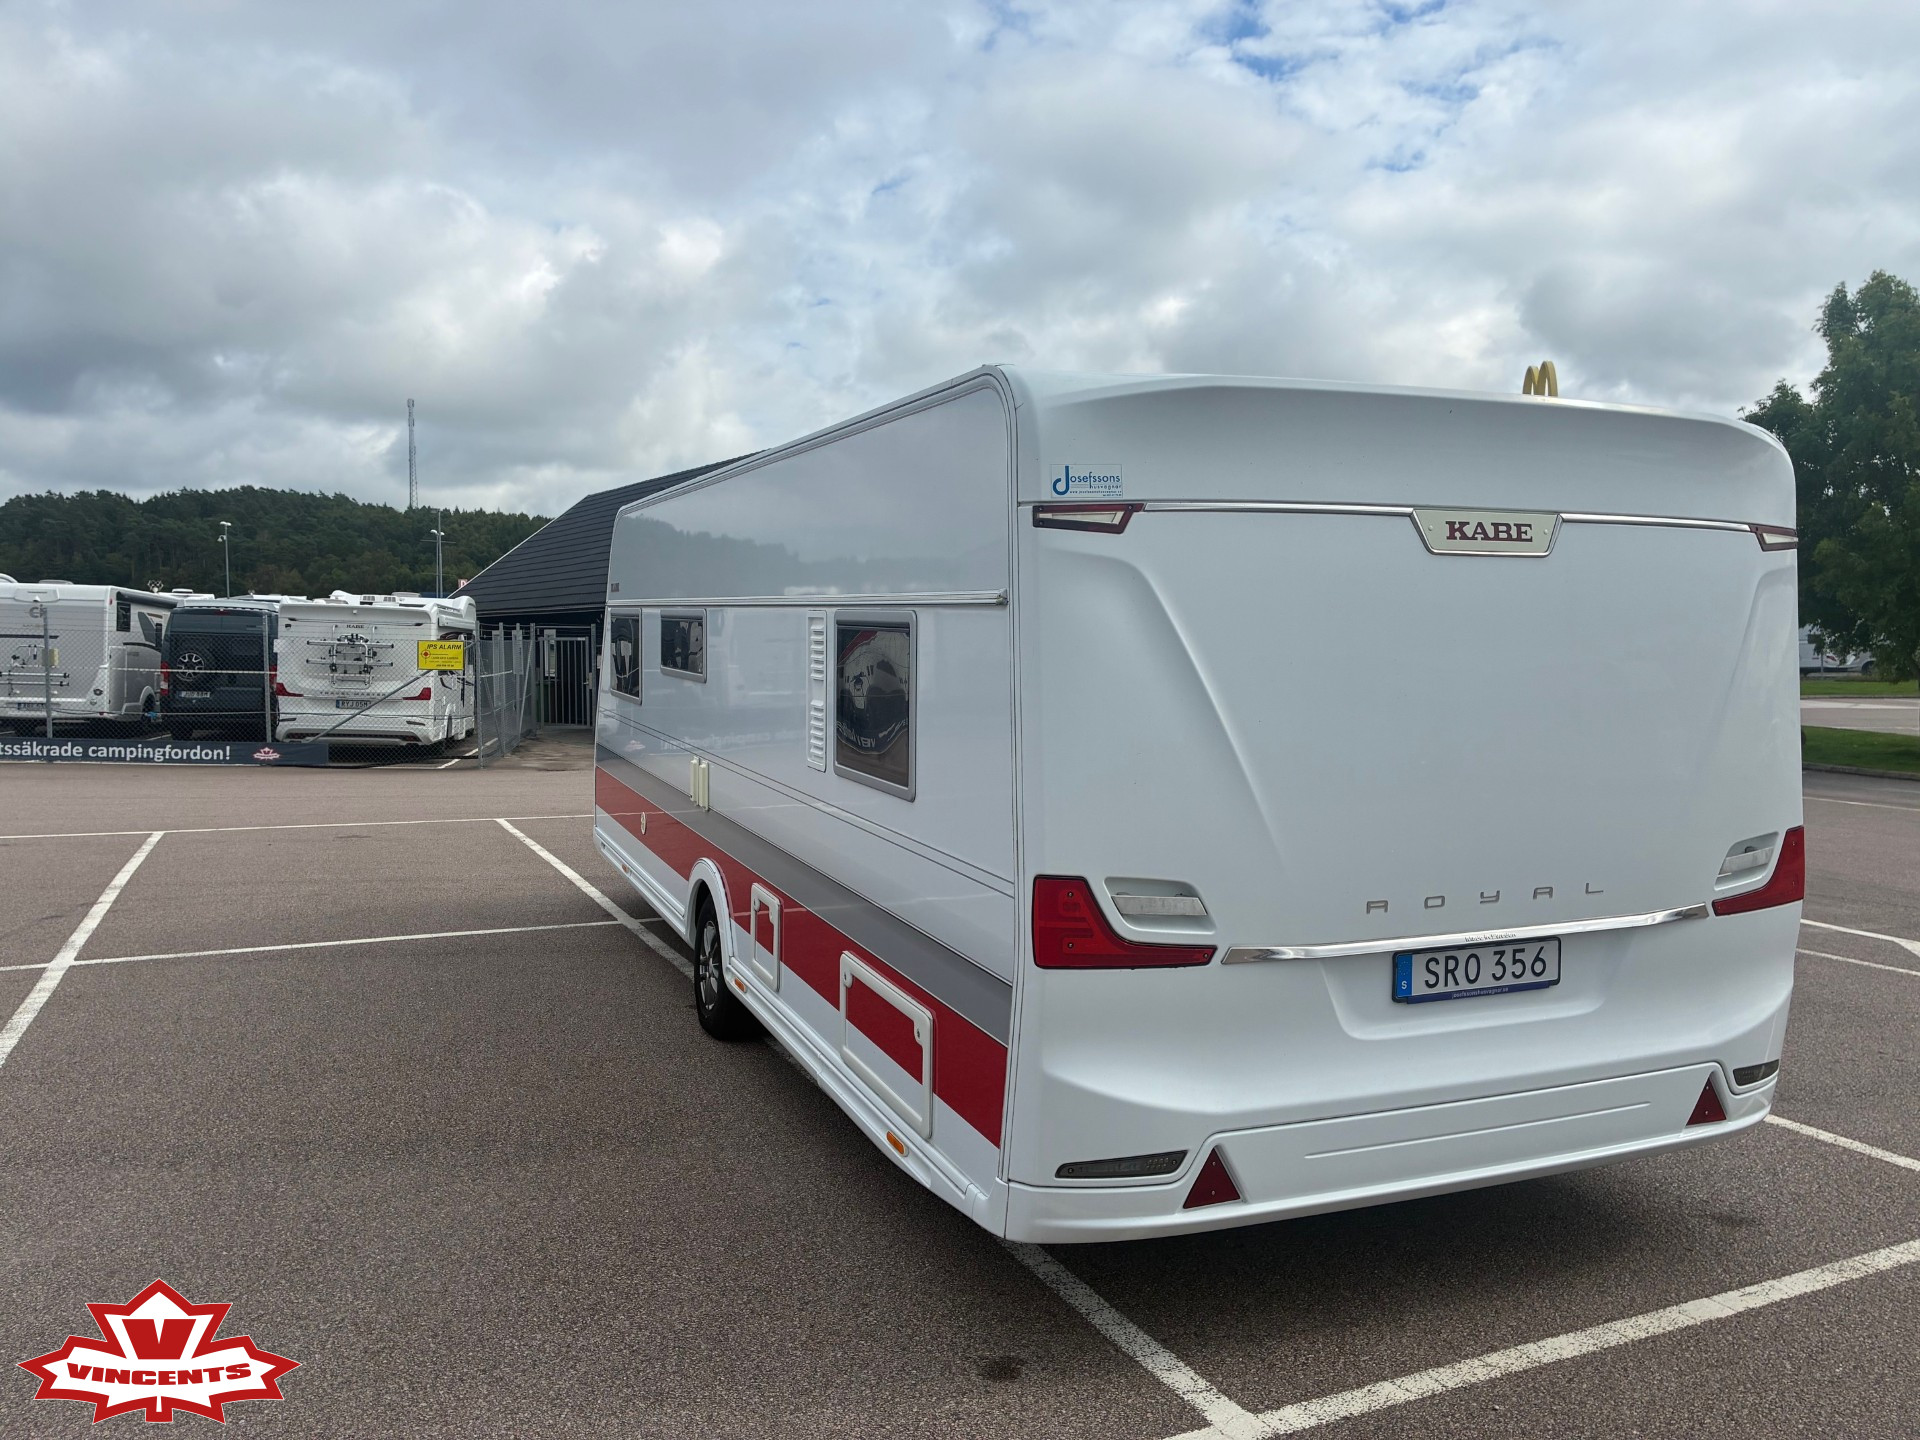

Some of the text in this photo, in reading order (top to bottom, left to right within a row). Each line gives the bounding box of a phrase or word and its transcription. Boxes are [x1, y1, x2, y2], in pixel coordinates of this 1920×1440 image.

[1052, 465, 1121, 495] Josefssons
[1445, 521, 1533, 542] KABE
[88, 743, 231, 761] campingfordon!
[1366, 882, 1604, 914] ROYAL
[1425, 946, 1547, 988] SRO 356
[1401, 981, 1407, 990] S
